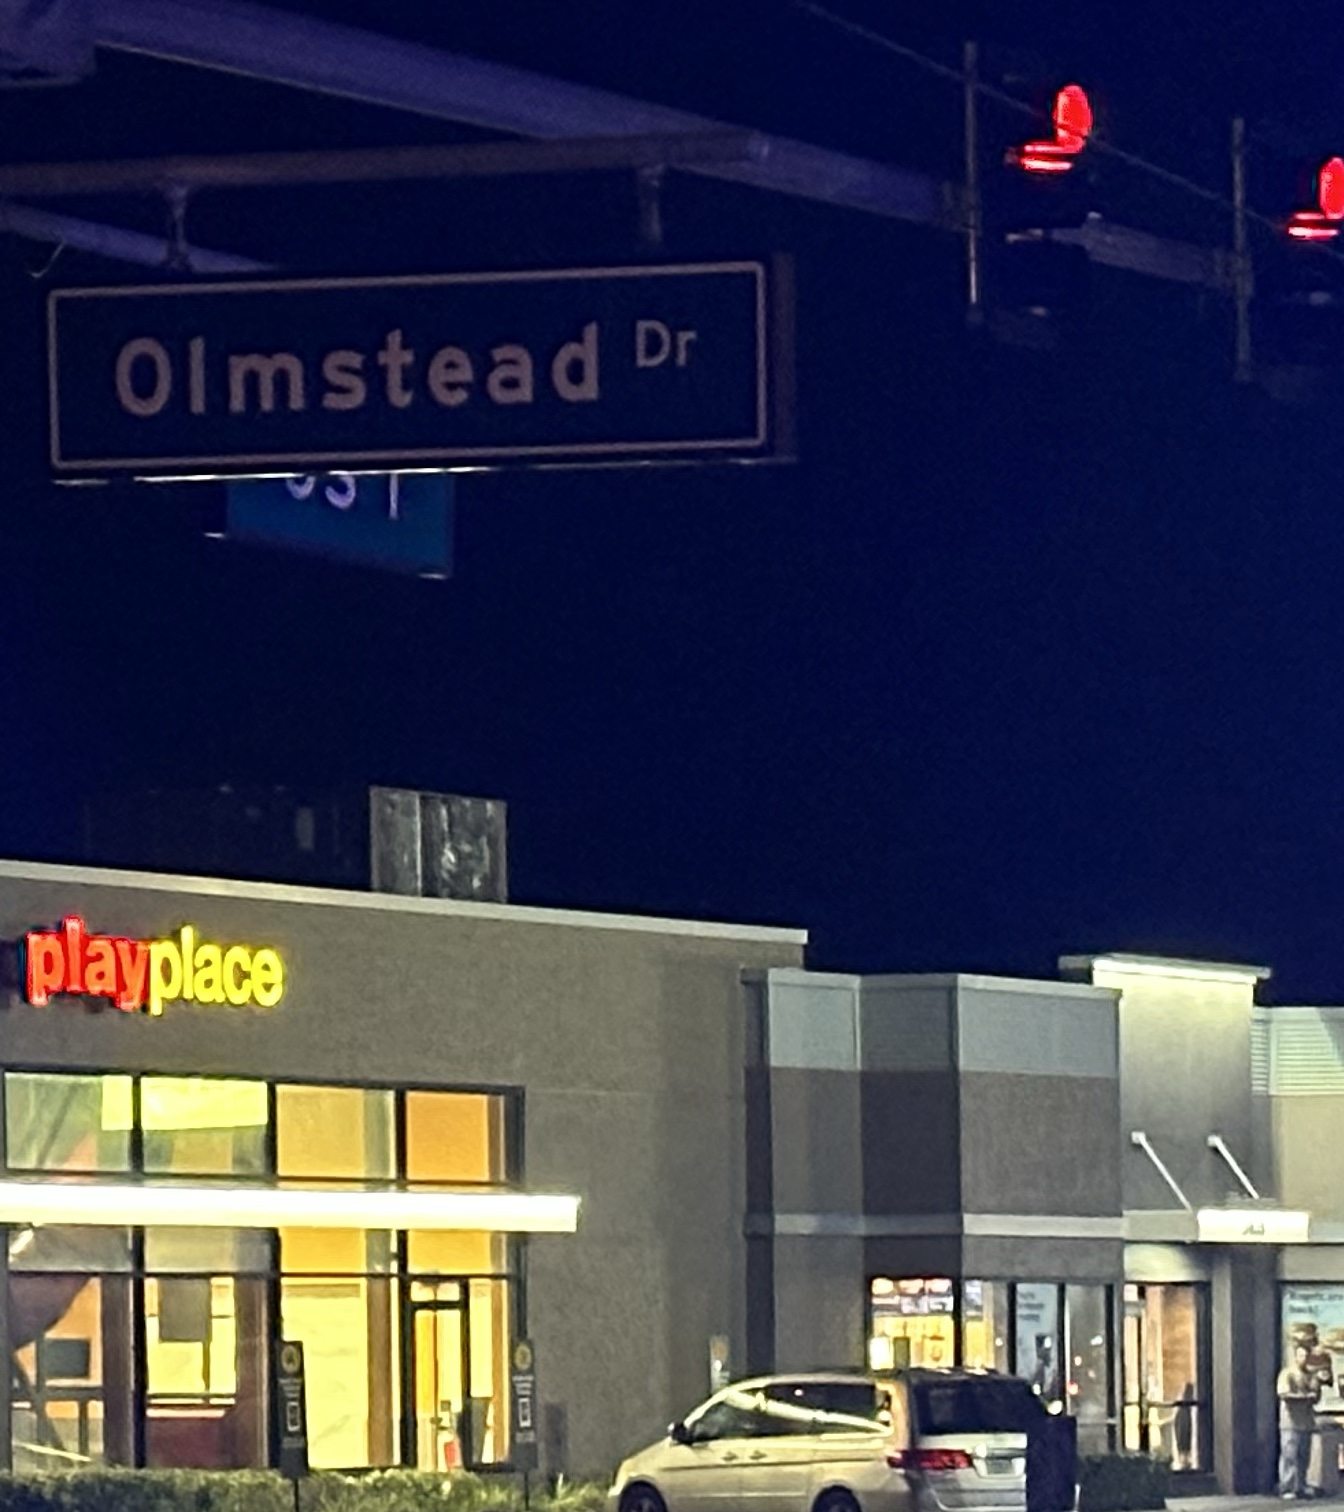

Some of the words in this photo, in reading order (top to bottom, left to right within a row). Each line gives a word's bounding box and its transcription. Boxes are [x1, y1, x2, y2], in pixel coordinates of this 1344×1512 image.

[114, 321, 602, 418] Olmstead
[634, 319, 697, 369] Dr
[27, 916, 284, 1016] playplace
